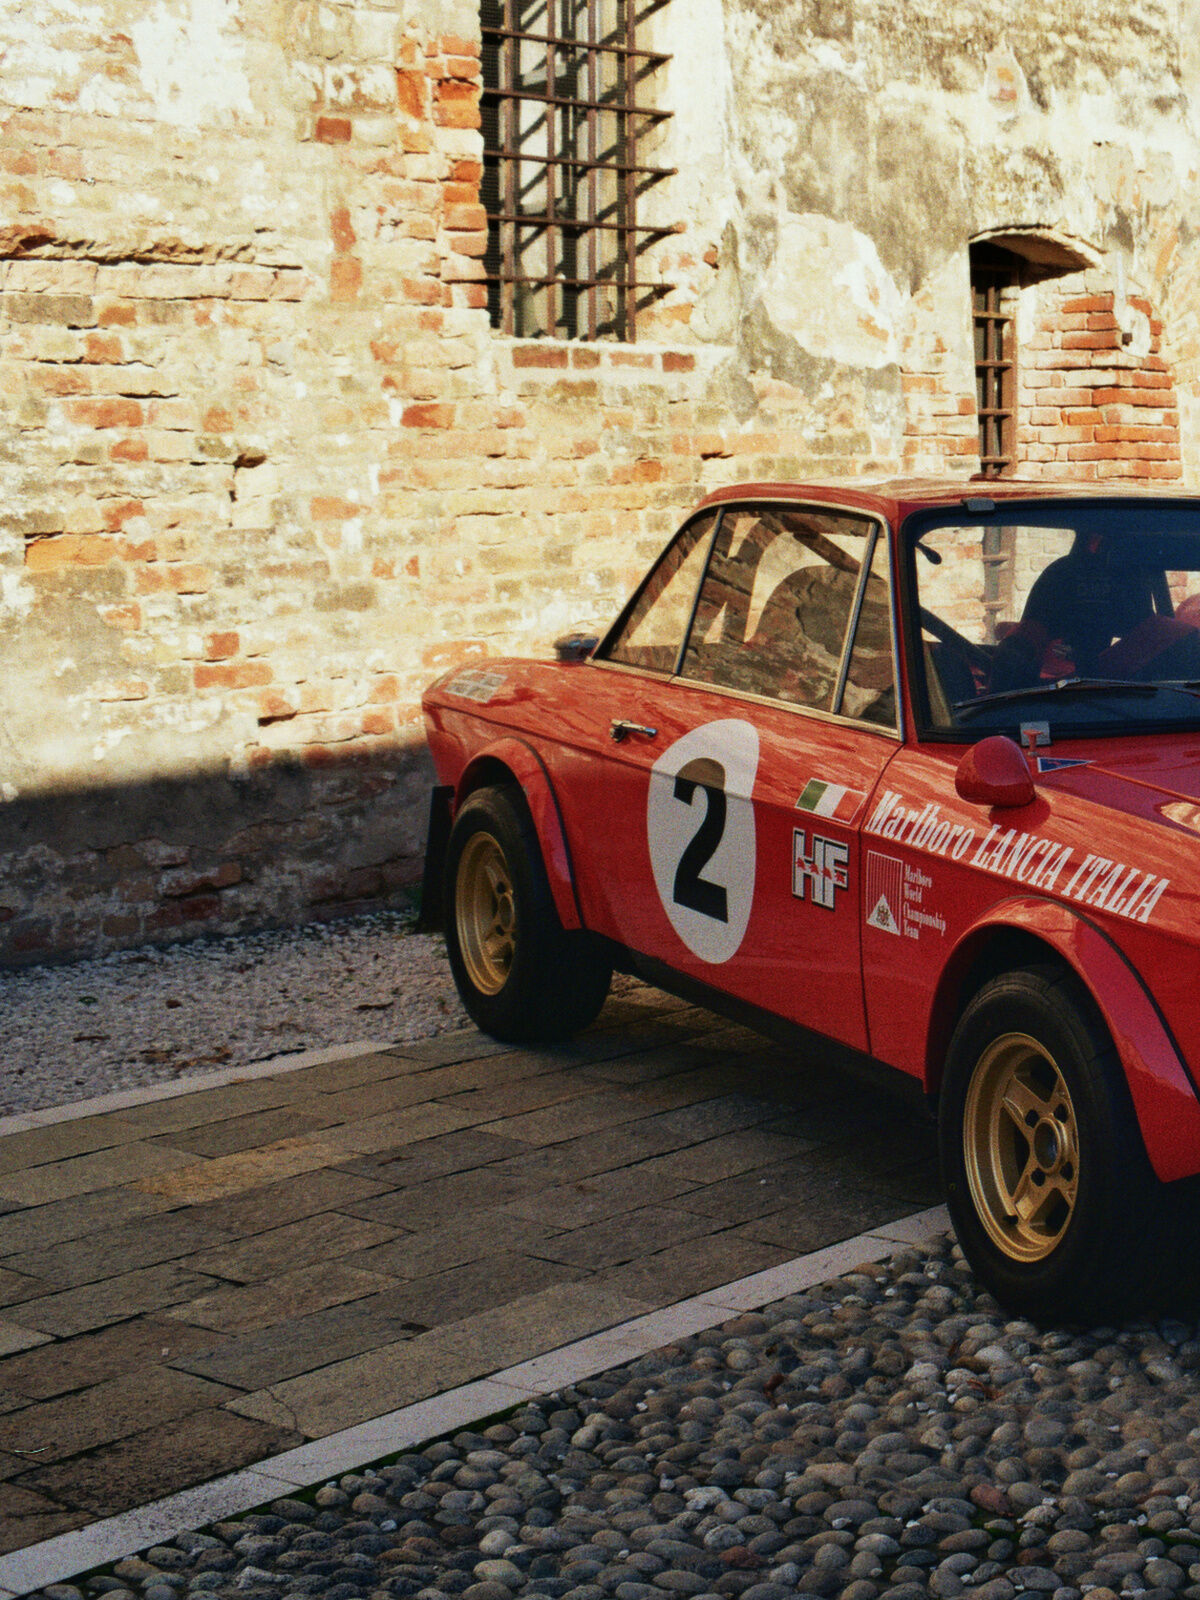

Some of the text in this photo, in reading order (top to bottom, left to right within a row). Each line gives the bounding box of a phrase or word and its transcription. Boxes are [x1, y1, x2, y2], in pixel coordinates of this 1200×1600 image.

[672, 756, 729, 924] 2
[865, 790, 1170, 923] Marlboro LANCIA ITALIA
[791, 826, 850, 911] HF
[904, 863, 933, 889] Marlboro
[904, 882, 923, 904] World
[903, 900, 946, 937] Championship
[904, 918, 919, 940] Team
